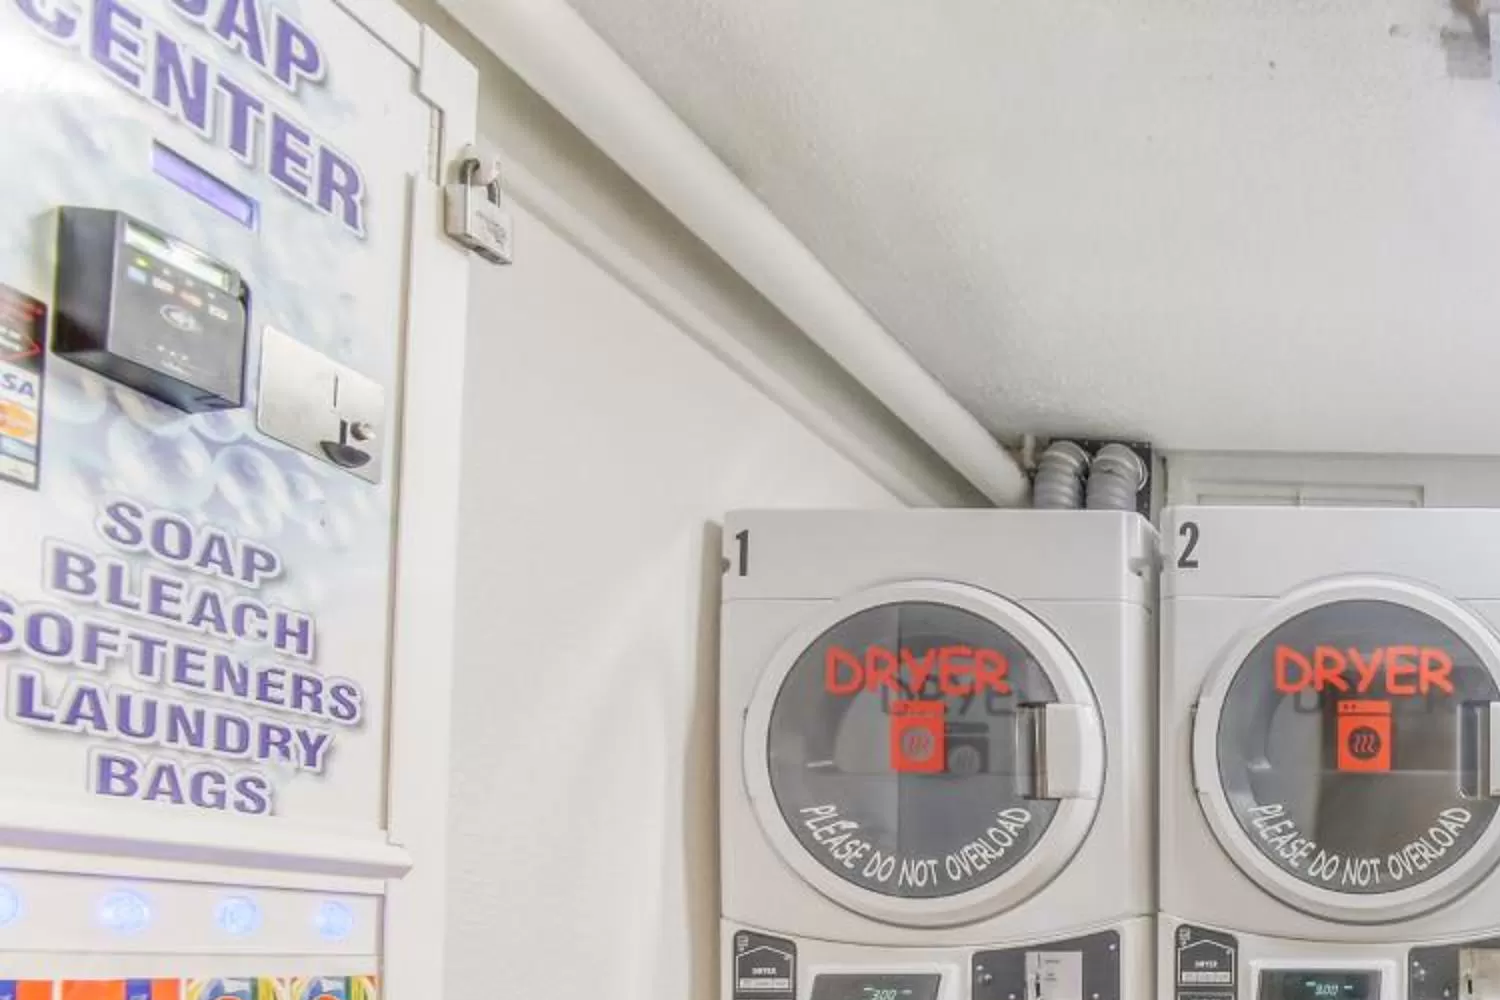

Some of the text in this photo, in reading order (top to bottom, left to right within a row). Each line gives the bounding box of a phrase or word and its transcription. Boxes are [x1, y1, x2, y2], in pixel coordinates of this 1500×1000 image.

[176, 0, 322, 88] AP
[0, 372, 35, 398] SA
[102, 500, 279, 584] SOAP
[734, 529, 749, 577] 1
[1176, 521, 1200, 569] 2
[53, 546, 311, 656] BLEACH
[823, 645, 1012, 695] DRYER
[1273, 643, 1455, 696] DRYER
[15, 673, 329, 769] LAUNDRY
[94, 753, 271, 817] BAGS
[800, 804, 1032, 888] PLEASE DO NOT OVERLOAD
[1247, 803, 1473, 887] PLEASE DO NOT OVERLOAD
